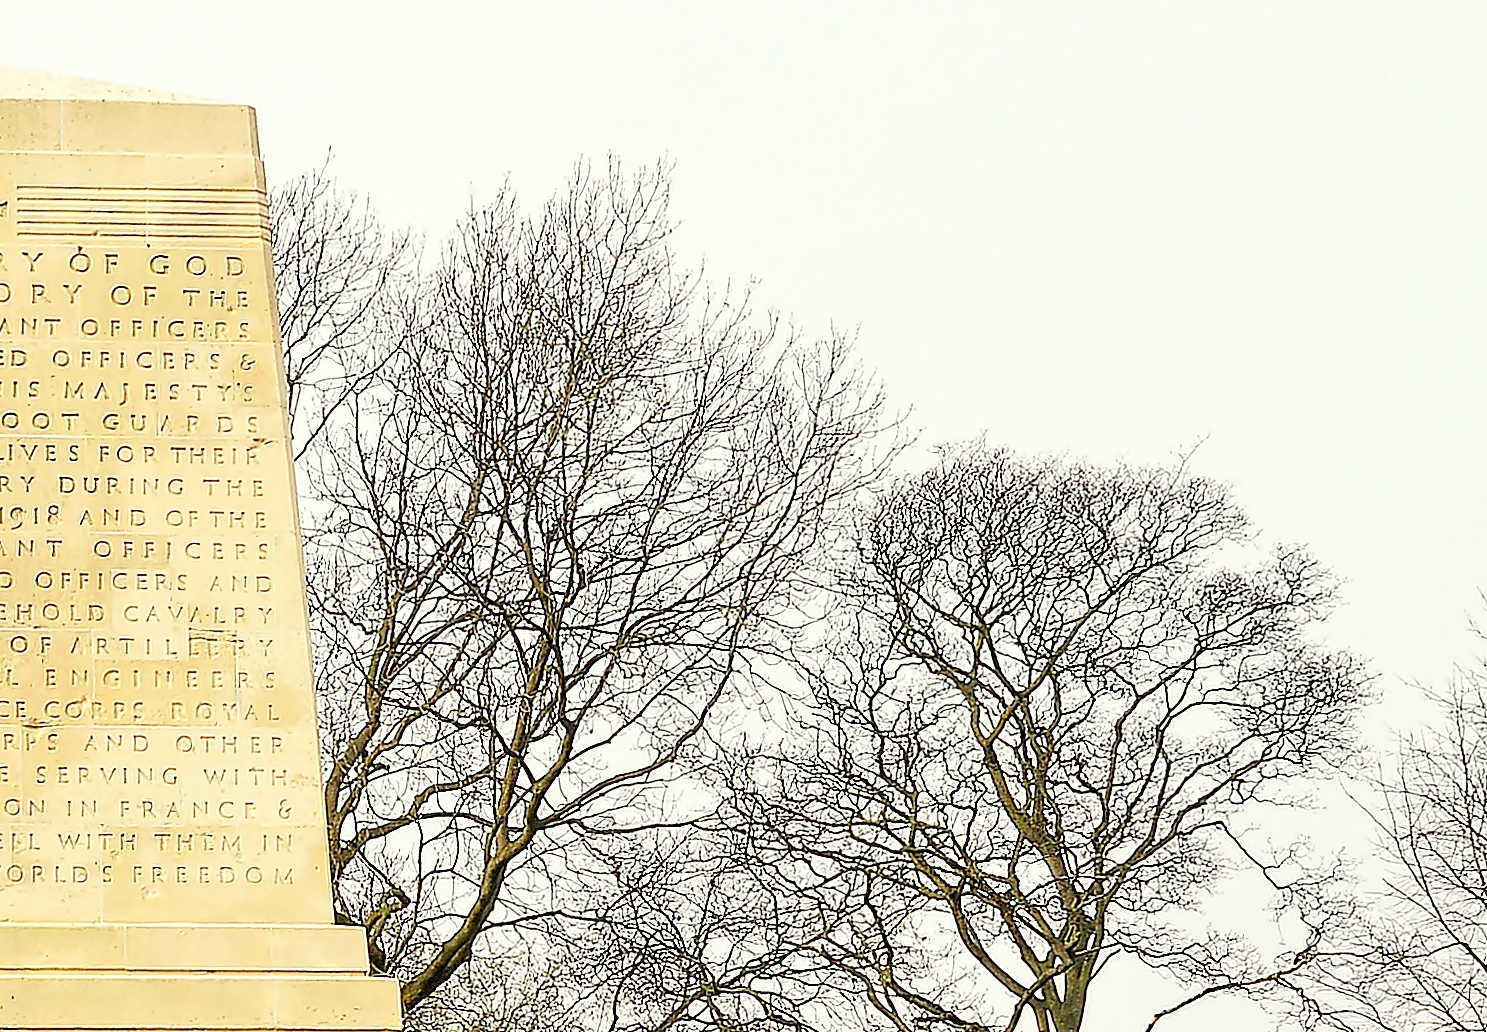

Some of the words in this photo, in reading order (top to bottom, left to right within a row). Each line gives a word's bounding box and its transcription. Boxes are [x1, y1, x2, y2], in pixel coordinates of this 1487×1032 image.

[69, 252, 118, 274] OF
[150, 255, 245, 276] GOD
[111, 286, 157, 305] OF
[182, 290, 248, 308] THE
[81, 319, 249, 339] OFFICERS
[52, 350, 220, 370] OFFICERS
[239, 353, 256, 371] &
[63, 381, 253, 405] MAJESTY'S
[102, 414, 258, 433] GUARDS
[99, 445, 155, 463] FOR
[170, 446, 260, 465] THEIR
[59, 476, 184, 495] DURING
[203, 479, 264, 497] THE
[79, 508, 146, 527] AND
[165, 510, 199, 528] OF
[209, 511, 266, 529] THE
[93, 540, 269, 560] OFFICERS
[34, 571, 188, 591] OFFICERS
[210, 575, 272, 593] AND
[124, 605, 273, 624] CAVALRY
[10, 636, 51, 654] OF
[70, 637, 274, 657] ARTILLERY
[46, 669, 276, 690] ENGINEERS
[44, 701, 145, 721] CORPS
[171, 702, 280, 722] ROYAL
[83, 735, 150, 752] AND
[176, 735, 283, 755] OTHER
[36, 766, 178, 785] SERVING
[203, 767, 288, 787] WITH
[66, 799, 97, 815] IN
[120, 800, 257, 819] FRANCE
[278, 798, 292, 819] &
[58, 832, 136, 852] WITH
[154, 833, 241, 853] THEM
[262, 834, 293, 853] IN
[133, 866, 294, 885] FREEDOM
